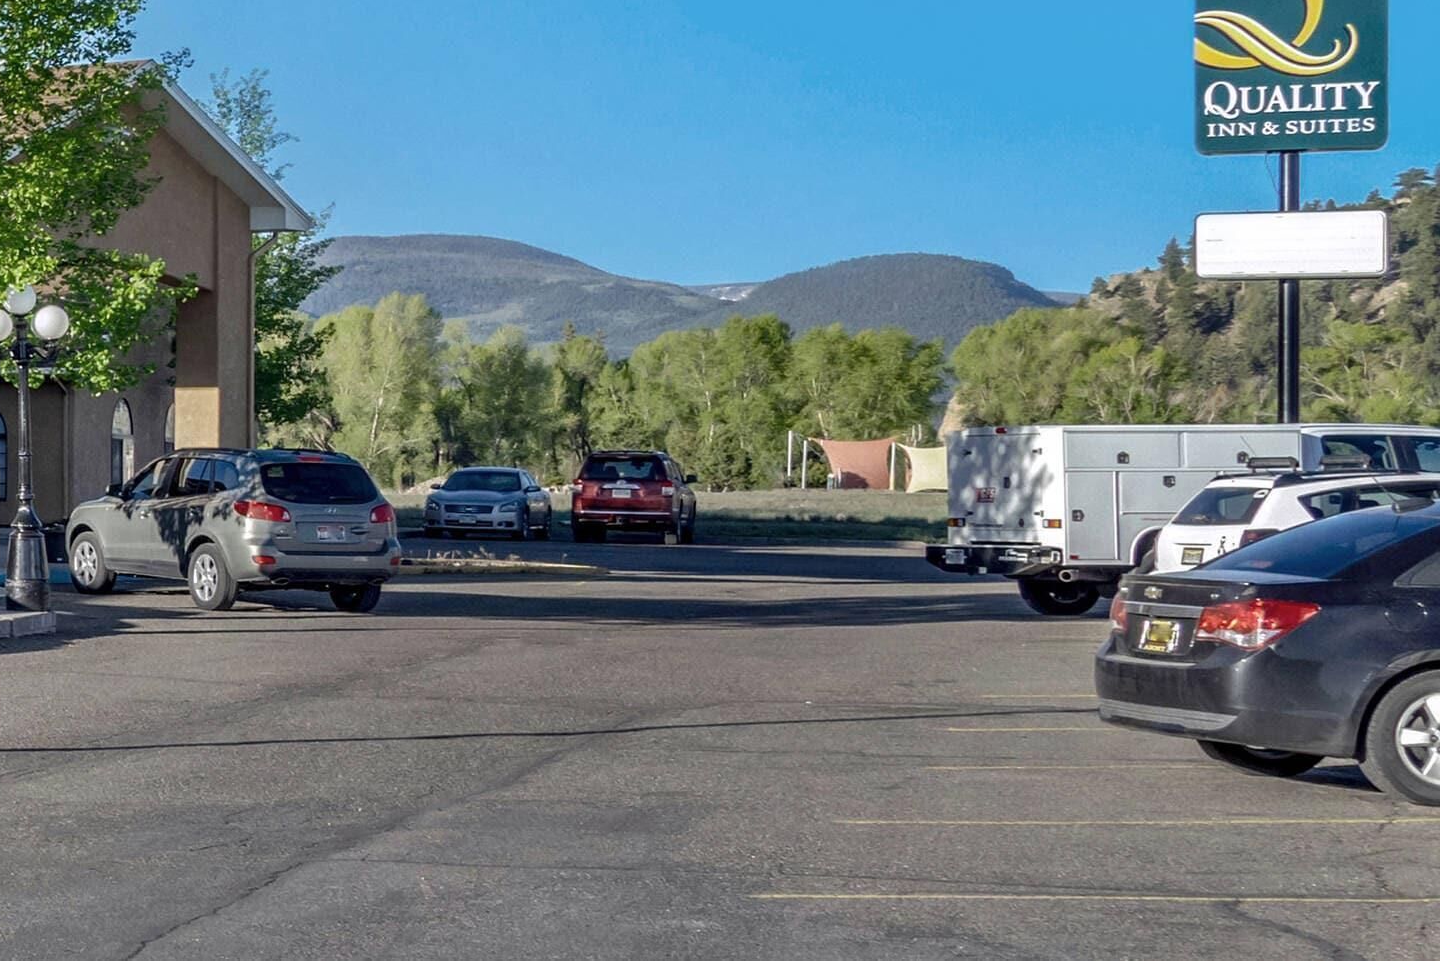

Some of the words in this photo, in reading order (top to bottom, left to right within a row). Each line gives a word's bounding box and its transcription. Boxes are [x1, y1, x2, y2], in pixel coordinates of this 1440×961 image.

[1204, 81, 1380, 119] QUALITY
[1206, 122, 1256, 137] INN
[1262, 121, 1280, 135] &
[1285, 117, 1375, 135] SUITES
